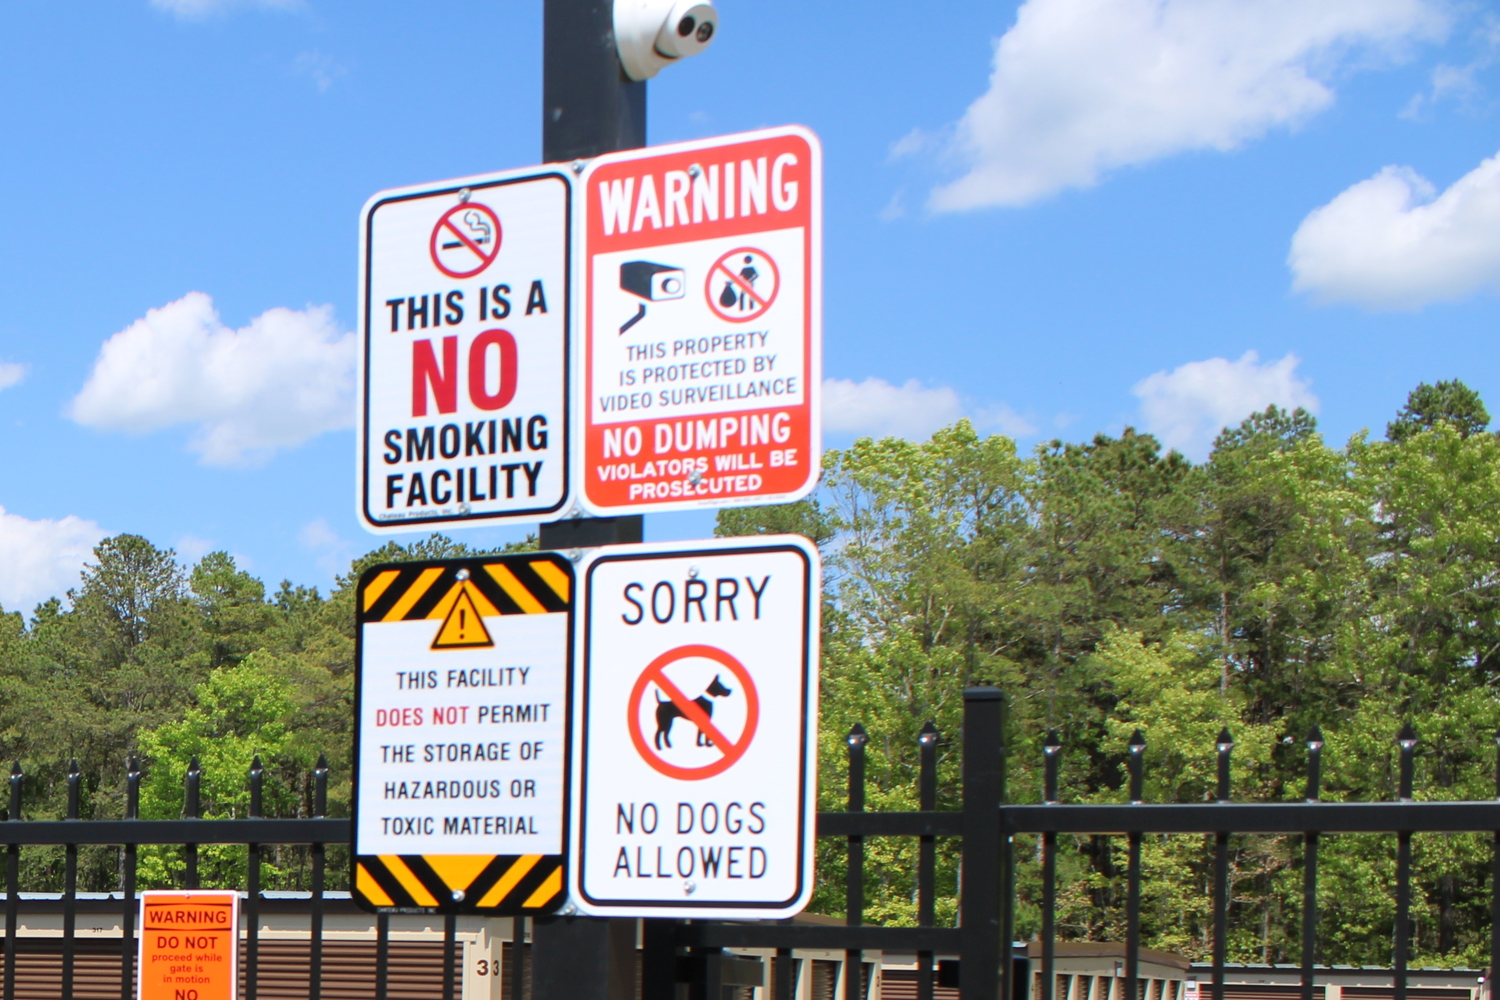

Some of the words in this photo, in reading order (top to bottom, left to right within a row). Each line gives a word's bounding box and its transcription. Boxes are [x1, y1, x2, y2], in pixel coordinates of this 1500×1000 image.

[598, 152, 798, 236] WARNING
[386, 290, 464, 333] THIS
[479, 284, 511, 321] IS
[525, 280, 548, 316] A
[626, 342, 666, 362] THIS
[673, 331, 769, 356] PROPERTY
[412, 328, 518, 417] NO
[619, 370, 635, 386] IS
[643, 358, 745, 385] PROTECTED
[754, 354, 777, 373] BY
[600, 391, 653, 413] VIDEO
[659, 377, 798, 407] SURVEILLANCE
[383, 414, 548, 464] SMOKING
[603, 426, 642, 459] NO
[654, 412, 791, 454] DUMPING
[598, 456, 708, 482] VIOLATORS
[715, 452, 763, 471] WILL
[770, 448, 798, 467] BE
[386, 461, 543, 508] FACILITY
[630, 475, 762, 500] PROSECUTED
[621, 575, 771, 626] SORRY
[397, 671, 437, 690] THIS
[447, 667, 530, 688] FACILITY
[376, 708, 423, 727] DOES
[433, 706, 470, 725] NOT
[478, 703, 551, 724] PERMIT
[381, 745, 414, 764] THE
[424, 742, 510, 762] STORAGE
[520, 741, 544, 760] OF
[384, 780, 501, 800] HAZARDOUS
[510, 779, 536, 798] OR
[381, 817, 434, 836] TOXIC
[443, 816, 538, 835] MATERIAL
[616, 803, 659, 835] NO
[677, 802, 767, 835] DOGS
[613, 846, 768, 879] ALLOWED
[149, 910, 227, 924] WARNING
[157, 937, 179, 949] DO
[185, 936, 218, 949] NOT
[152, 953, 192, 963] proceed
[195, 953, 222, 962] while
[170, 964, 192, 974] gate
[195, 964, 204, 973] is
[476, 960, 489, 976] 3
[493, 960, 499, 976] 3
[163, 975, 172, 983] in
[175, 975, 210, 984] motion
